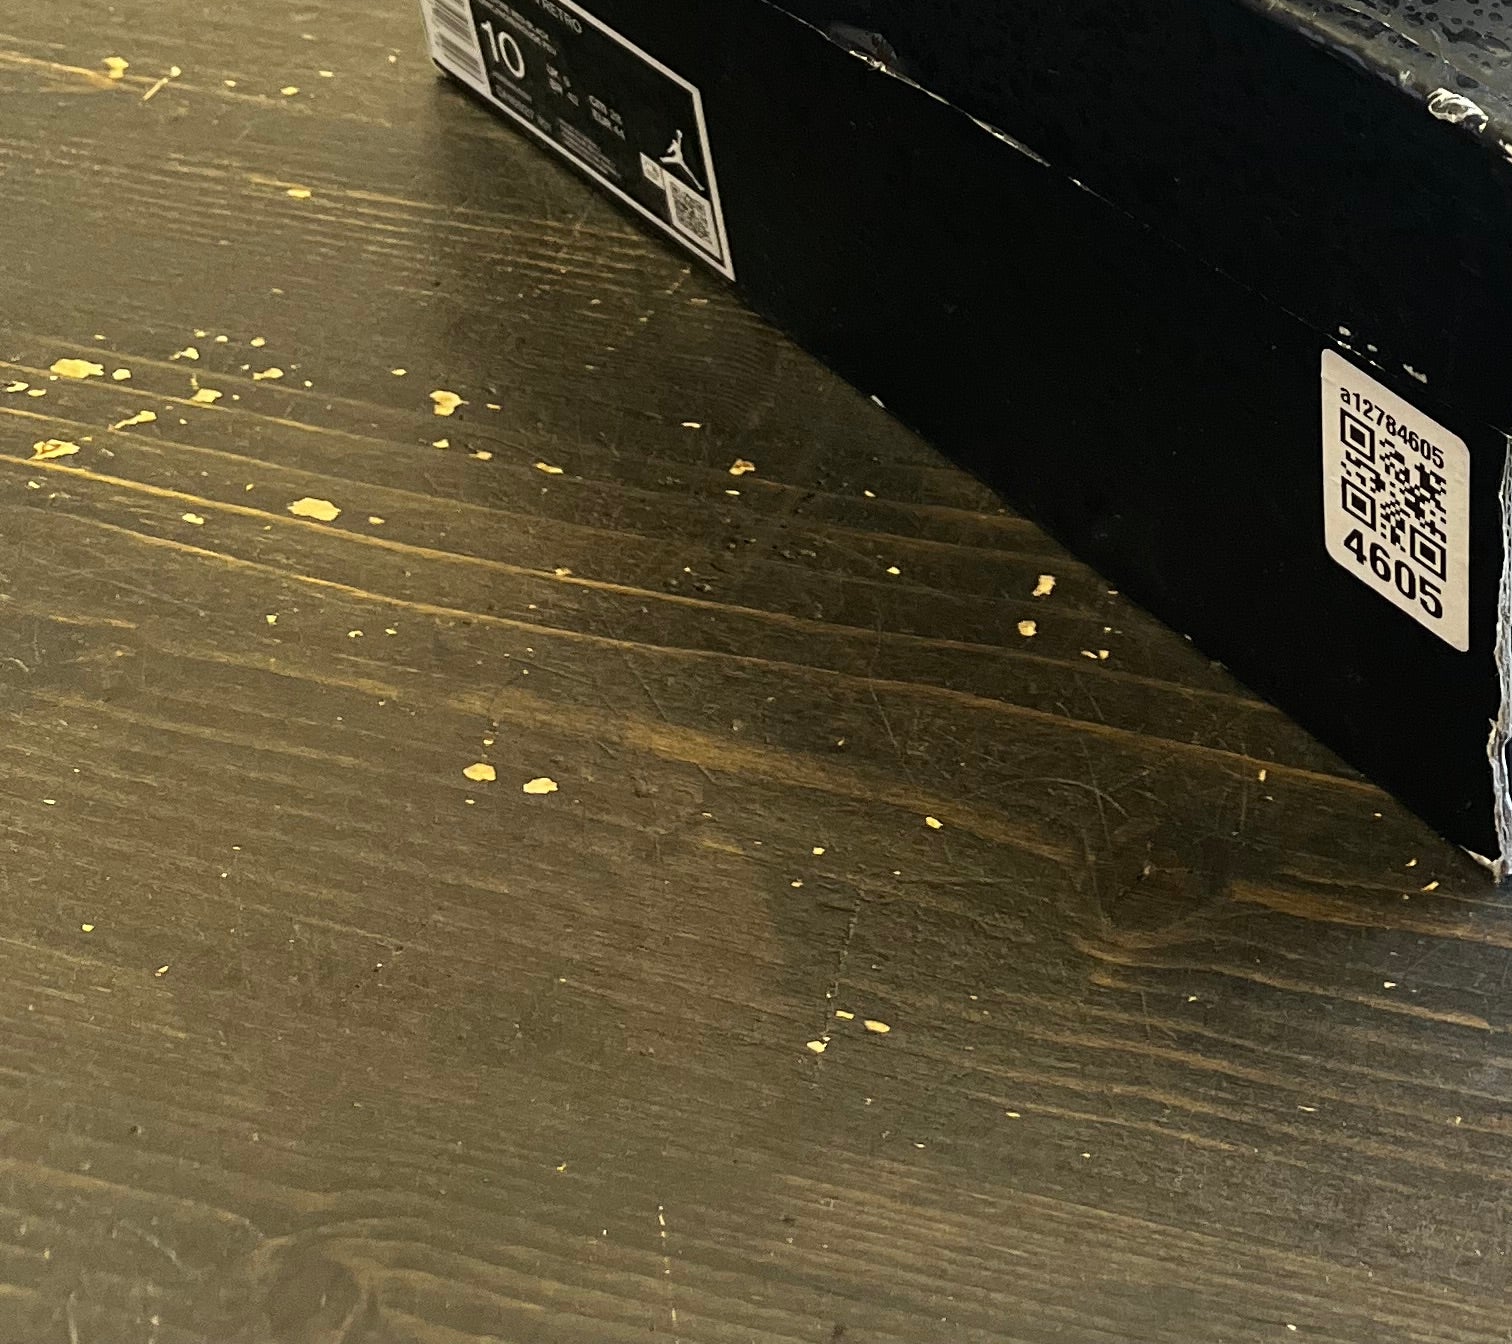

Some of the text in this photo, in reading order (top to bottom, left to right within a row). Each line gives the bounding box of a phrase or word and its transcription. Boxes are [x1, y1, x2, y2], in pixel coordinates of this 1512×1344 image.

[481, 20, 525, 79] 10
[1340, 387, 1444, 470] a12784605
[1344, 528, 1443, 619] 4605
